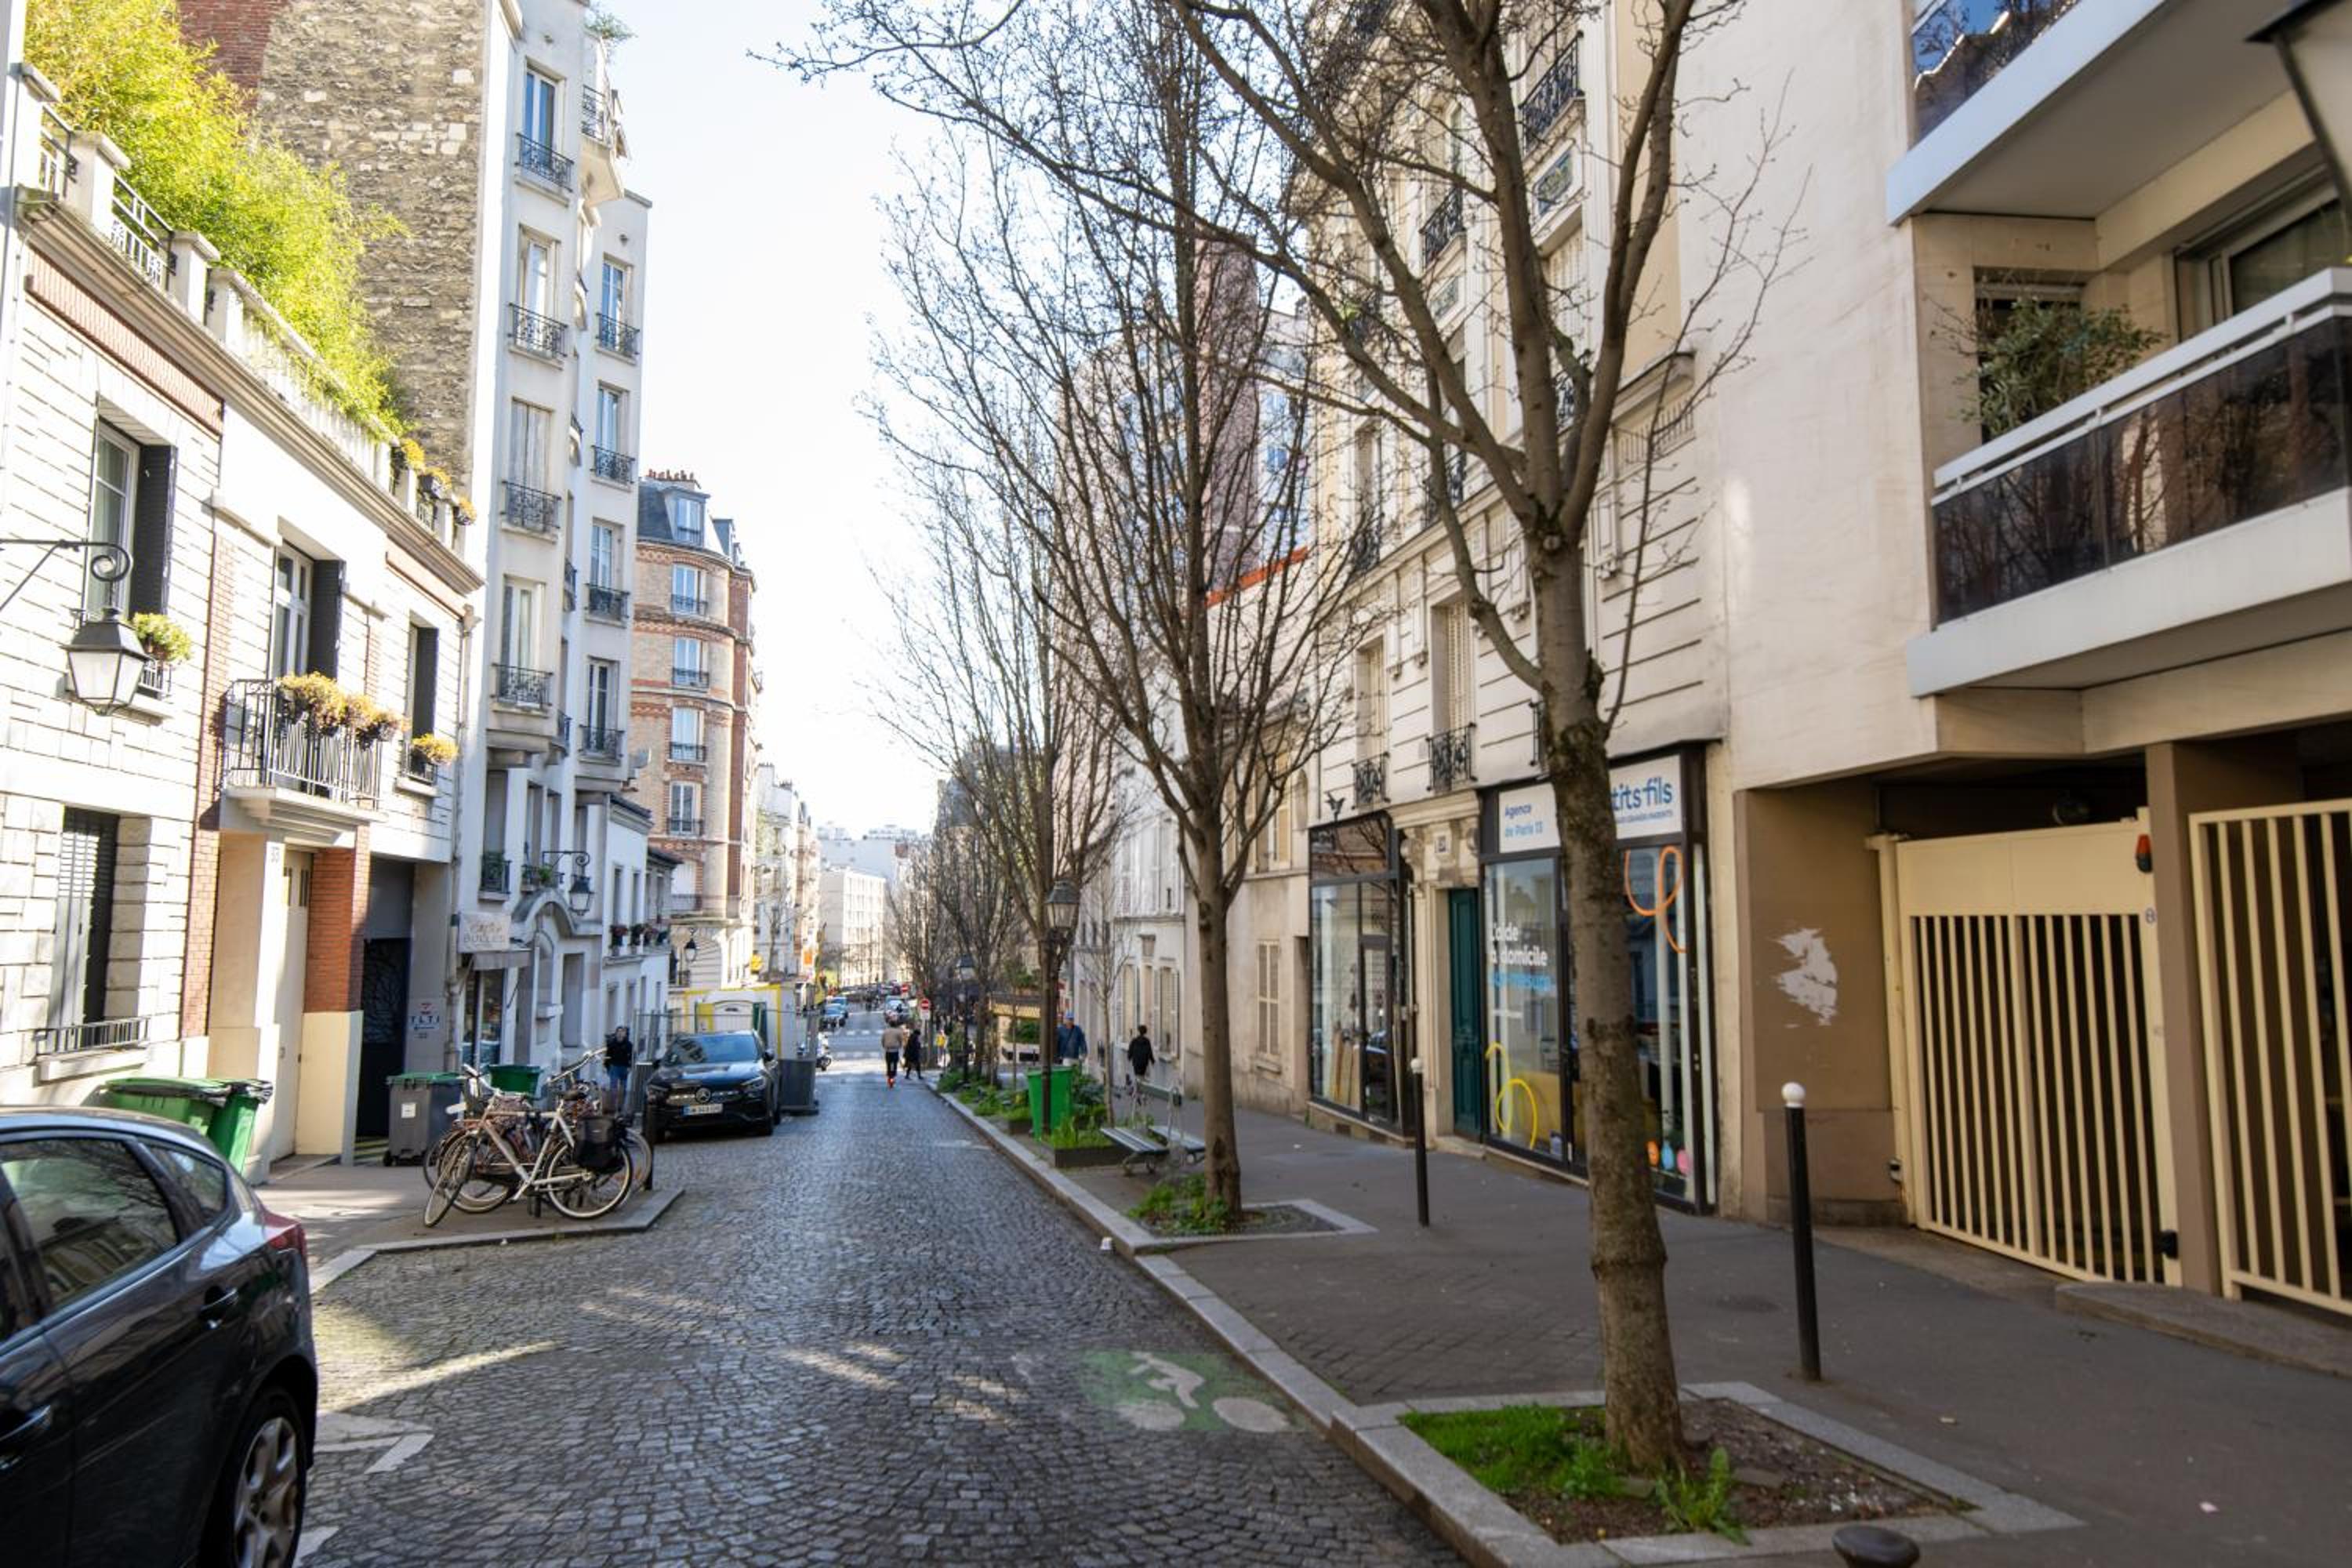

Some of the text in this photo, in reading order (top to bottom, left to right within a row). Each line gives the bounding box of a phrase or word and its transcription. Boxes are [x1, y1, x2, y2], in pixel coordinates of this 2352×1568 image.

[1610, 784, 1642, 811] tits
[1504, 804, 1532, 819] Agence
[1490, 922, 1519, 942] L'aide
[1500, 944, 1548, 967] domicile
